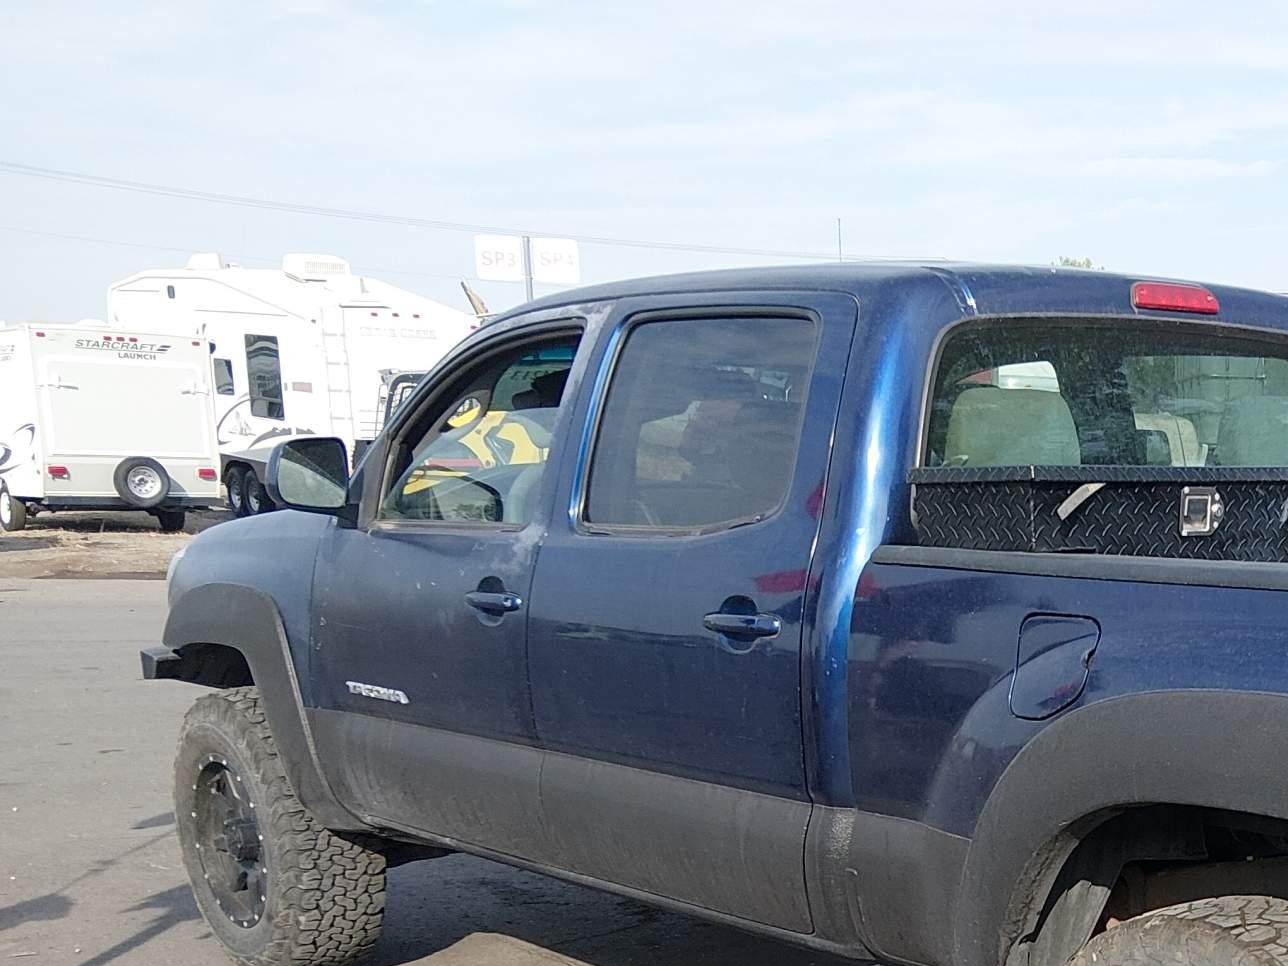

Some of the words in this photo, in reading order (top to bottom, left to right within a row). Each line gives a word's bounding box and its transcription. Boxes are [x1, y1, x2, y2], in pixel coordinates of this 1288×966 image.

[481, 250, 516, 267] SP3
[75, 340, 157, 352] STARCRAFT
[117, 352, 157, 360] LAUNCH
